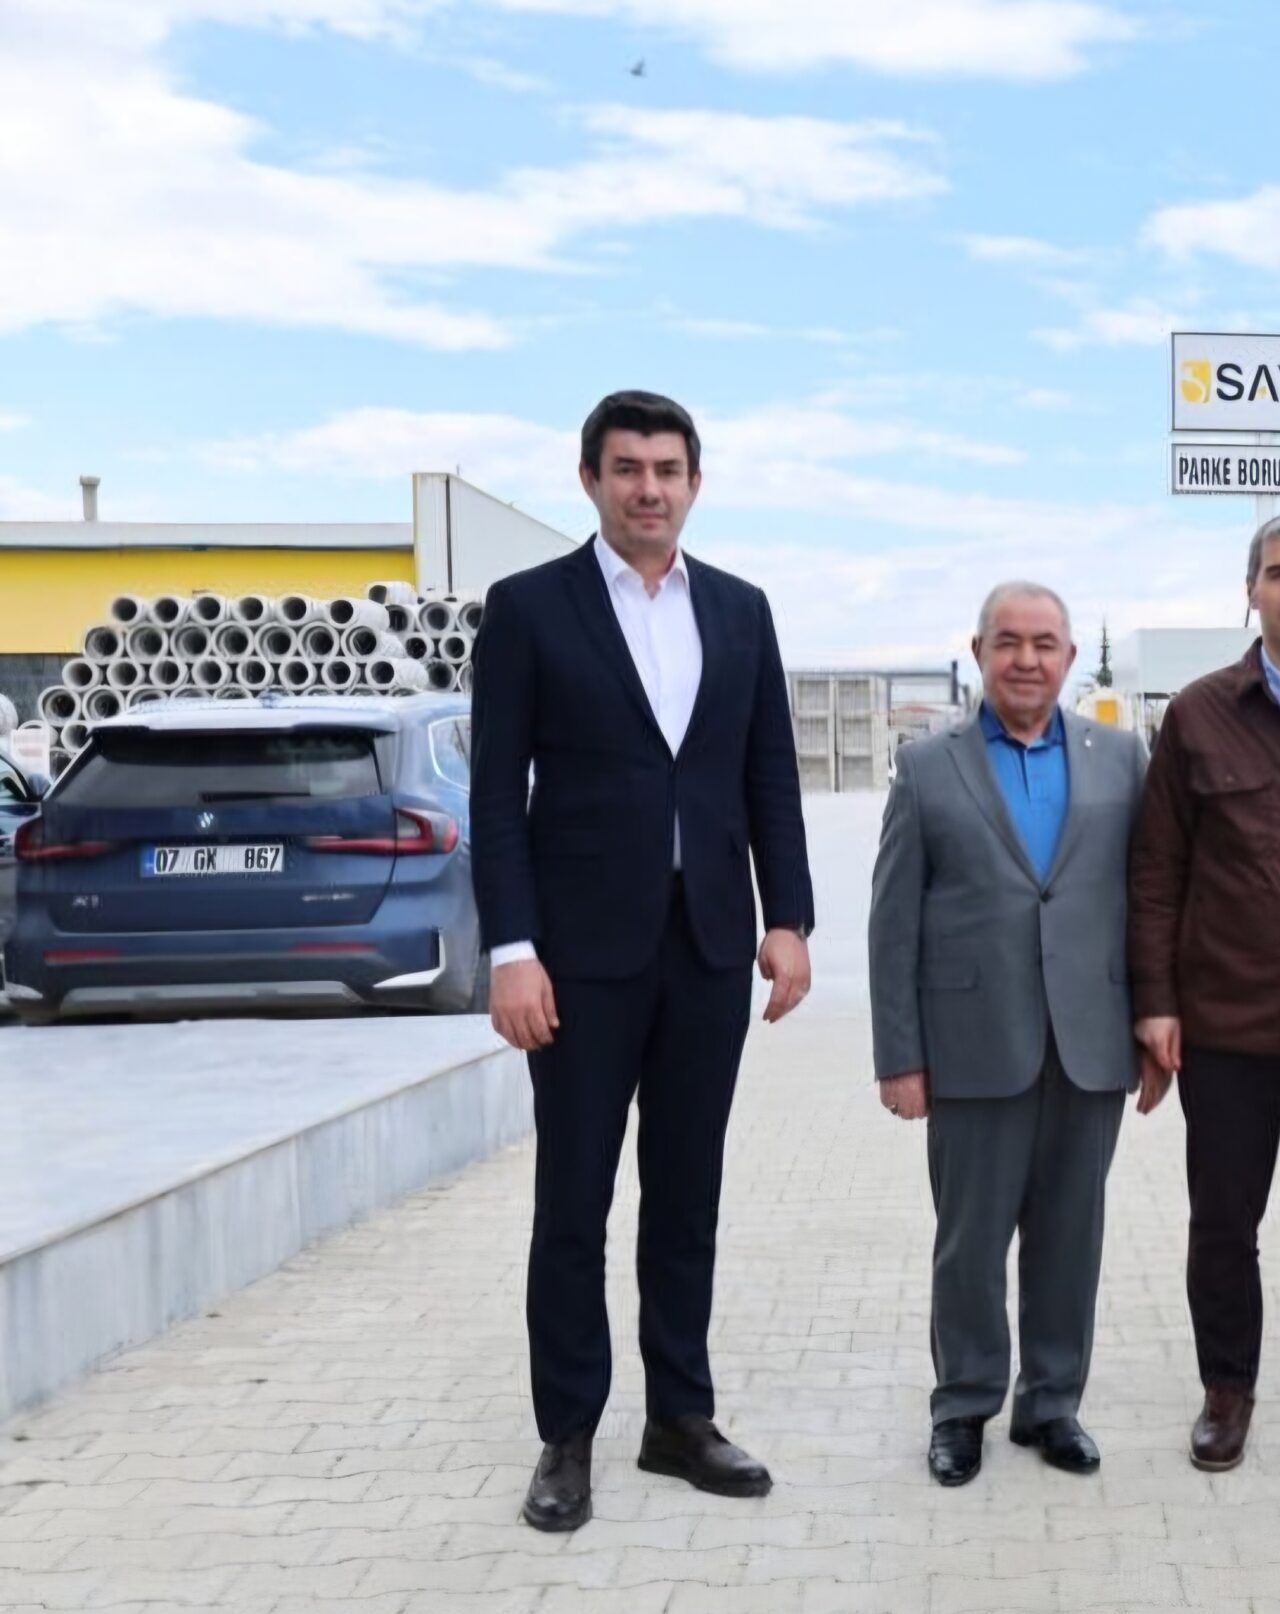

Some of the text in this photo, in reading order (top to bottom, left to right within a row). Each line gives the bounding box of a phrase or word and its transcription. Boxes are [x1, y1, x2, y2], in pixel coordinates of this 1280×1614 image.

[1179, 456, 1231, 486] PARKE
[155, 849, 180, 872] 07
[244, 847, 280, 871] 867
